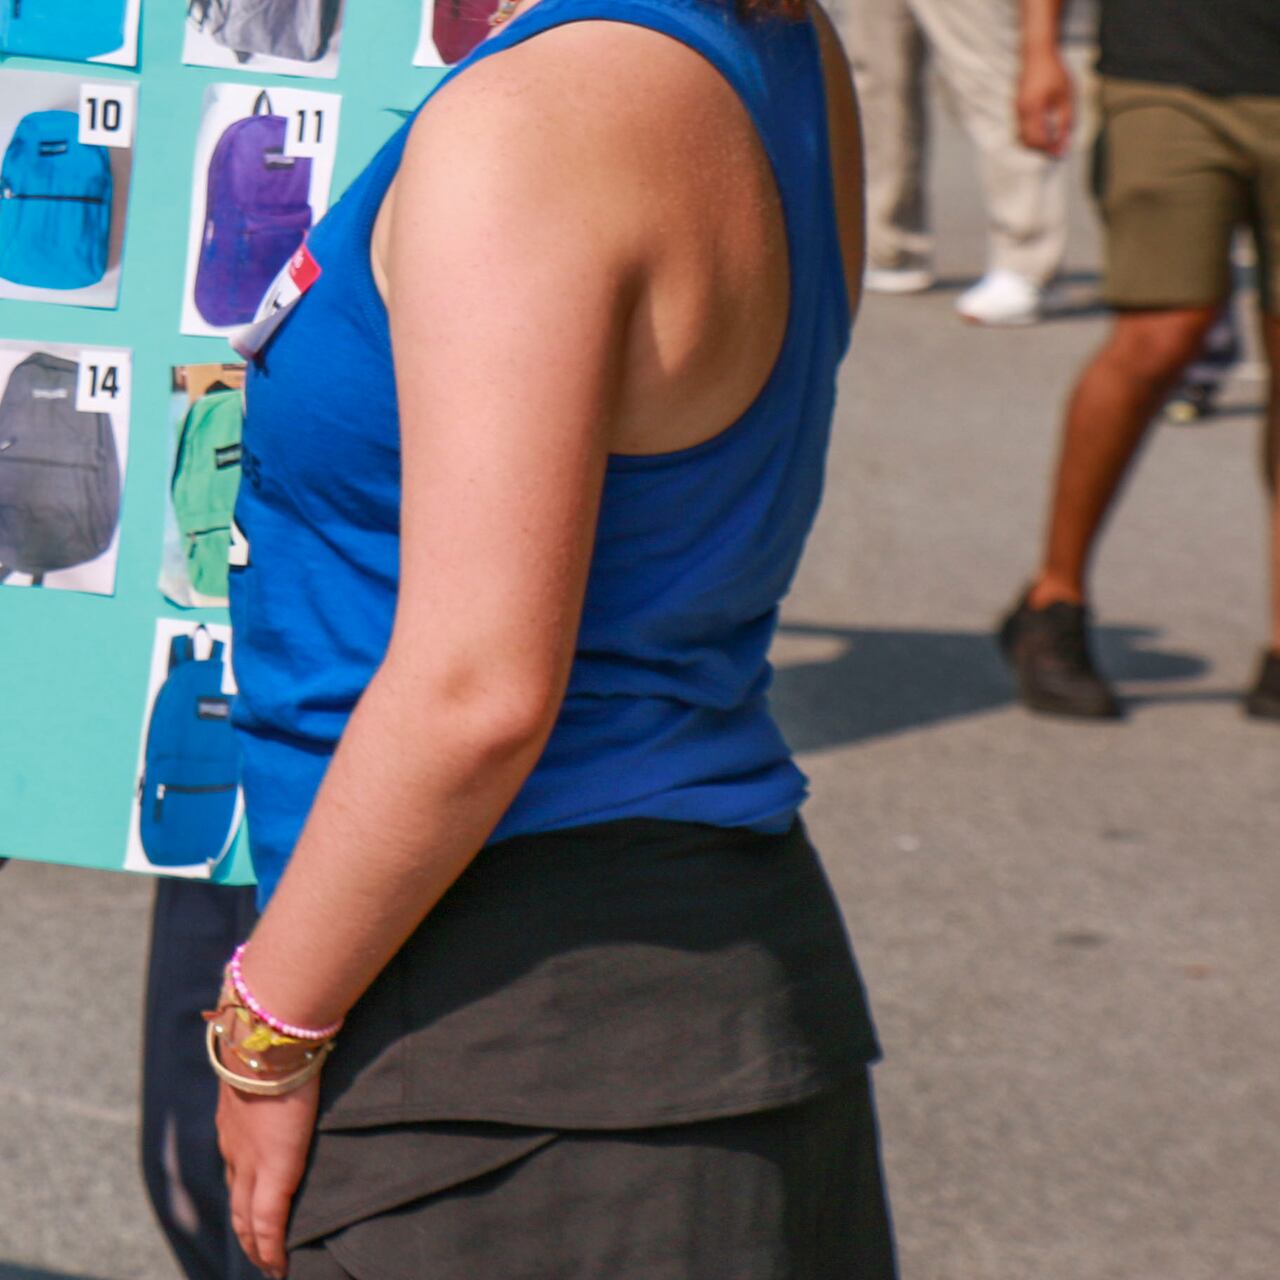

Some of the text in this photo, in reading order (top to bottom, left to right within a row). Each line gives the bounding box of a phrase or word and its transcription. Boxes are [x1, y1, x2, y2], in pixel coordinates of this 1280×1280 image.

[86, 97, 122, 132] 10
[297, 109, 323, 144] 11
[88, 365, 119, 399] 14
